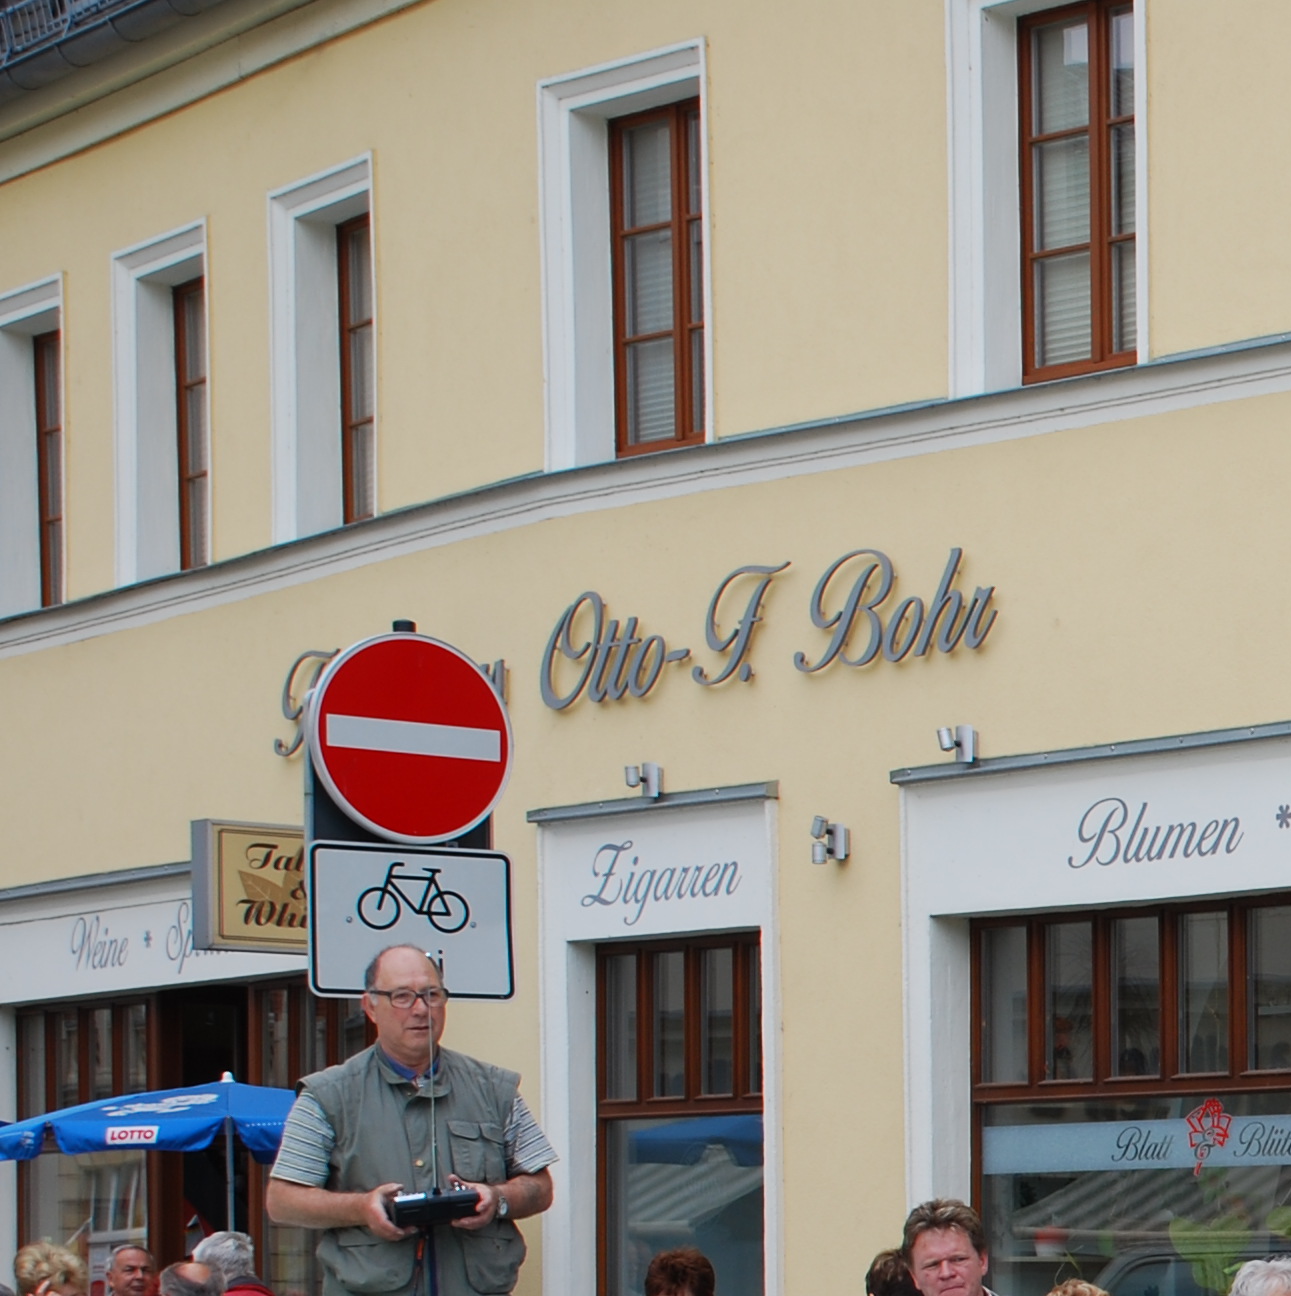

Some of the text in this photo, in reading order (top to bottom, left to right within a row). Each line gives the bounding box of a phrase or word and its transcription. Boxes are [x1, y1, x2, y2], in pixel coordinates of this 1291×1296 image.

[793, 547, 998, 673] Bohr
[1067, 796, 1244, 869] Blumen
[580, 839, 742, 926] Zigarren
[71, 915, 129, 971] Weine
[110, 1129, 154, 1141] LOTTO
[1111, 1126, 1174, 1162] Blatt
